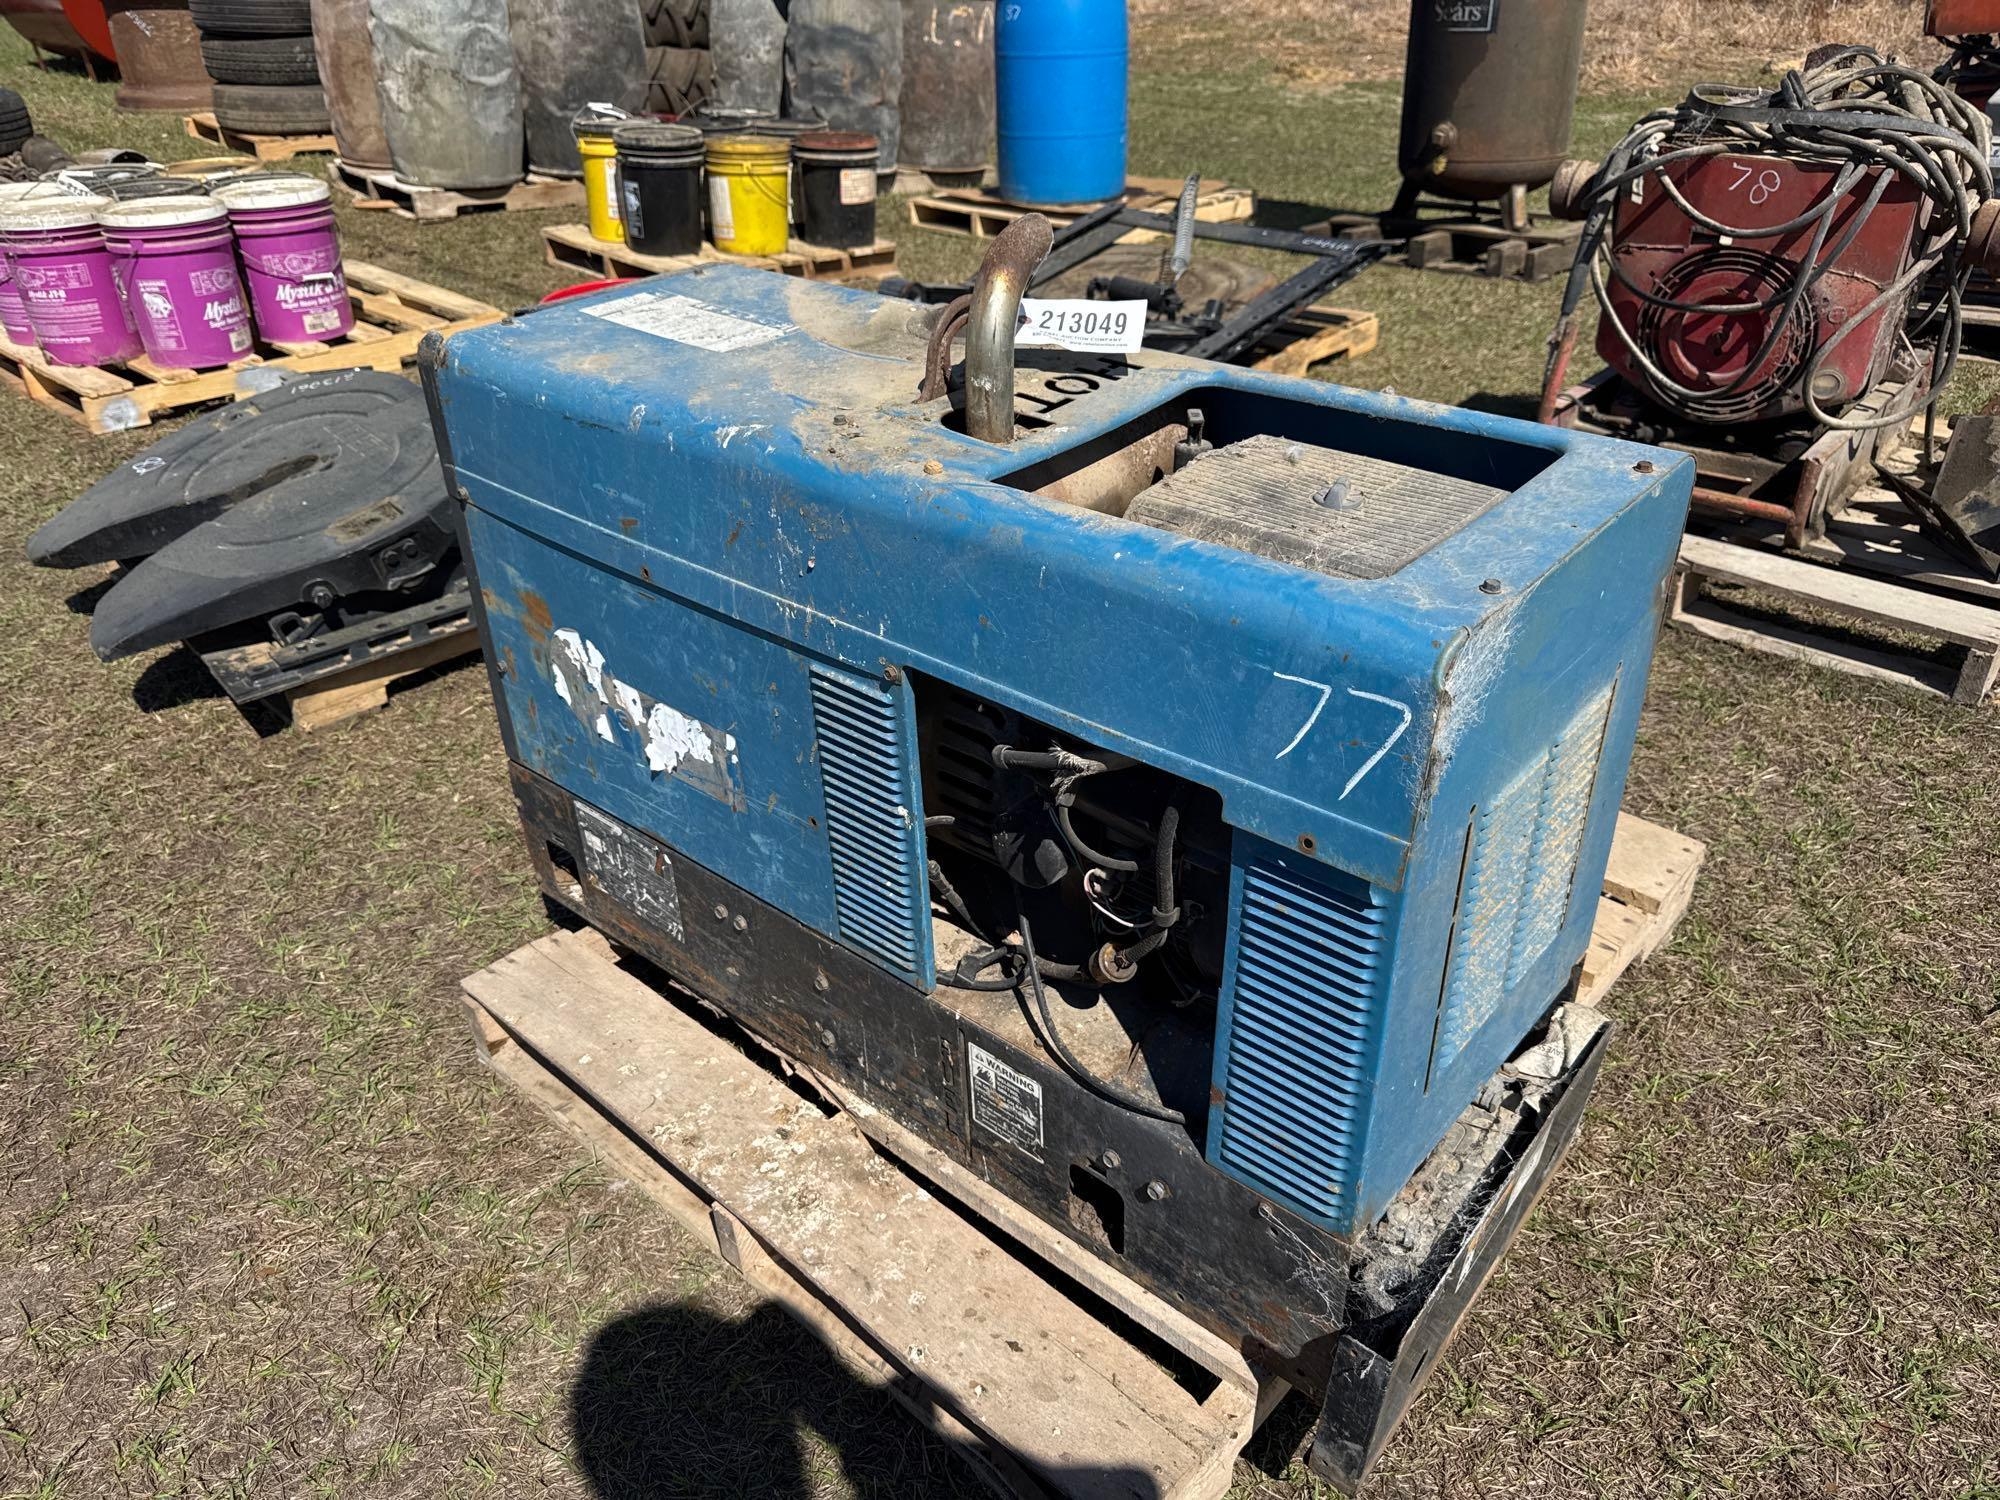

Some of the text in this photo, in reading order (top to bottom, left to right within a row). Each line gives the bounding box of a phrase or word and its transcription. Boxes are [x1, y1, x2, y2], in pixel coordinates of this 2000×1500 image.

[1728, 162, 1781, 204] 78
[275, 283, 323, 304] Mystik
[1039, 310, 1128, 335] 213049
[1014, 357, 1144, 414] HOT
[1273, 671, 1412, 801] 77
[985, 1058, 1035, 1093] WARNING
